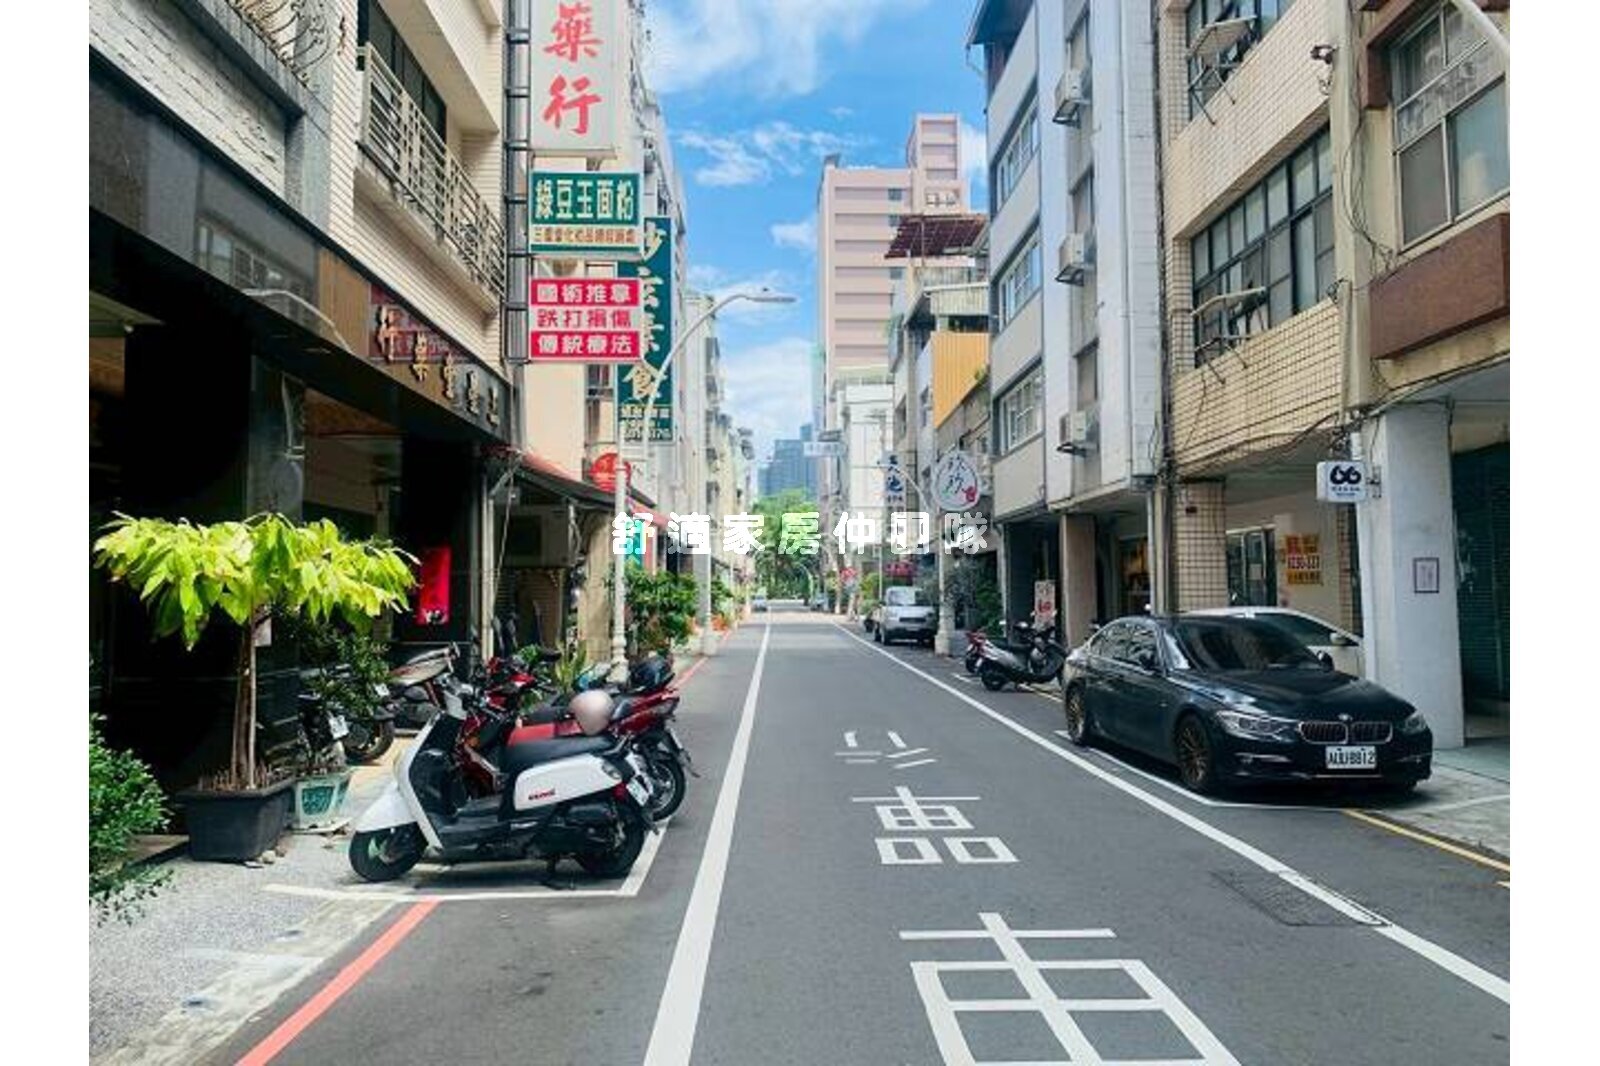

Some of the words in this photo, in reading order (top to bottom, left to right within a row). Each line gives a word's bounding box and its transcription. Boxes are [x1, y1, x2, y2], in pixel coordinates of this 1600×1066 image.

[537, 309, 631, 328] 跌打損傷
[538, 334, 633, 354] 傳統療法
